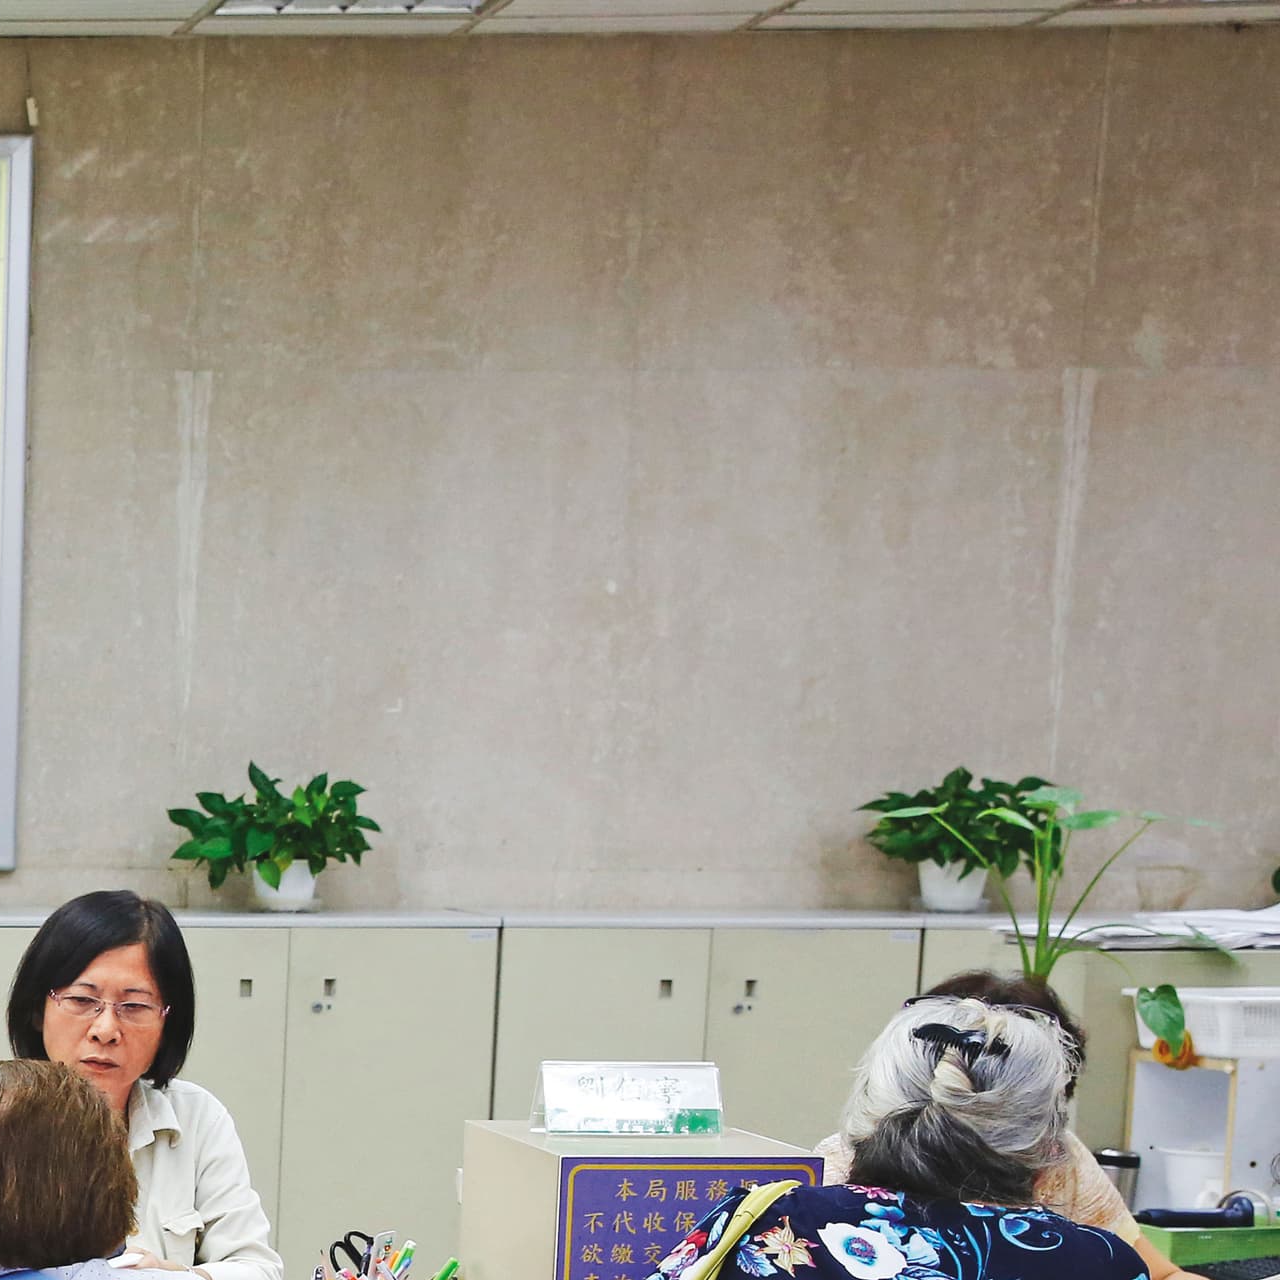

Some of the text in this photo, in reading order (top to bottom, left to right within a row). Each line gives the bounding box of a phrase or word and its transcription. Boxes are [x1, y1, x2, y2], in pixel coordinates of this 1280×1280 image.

[584, 1211, 696, 1234] 不代收保
[580, 1243, 662, 1265] 欲繳交
